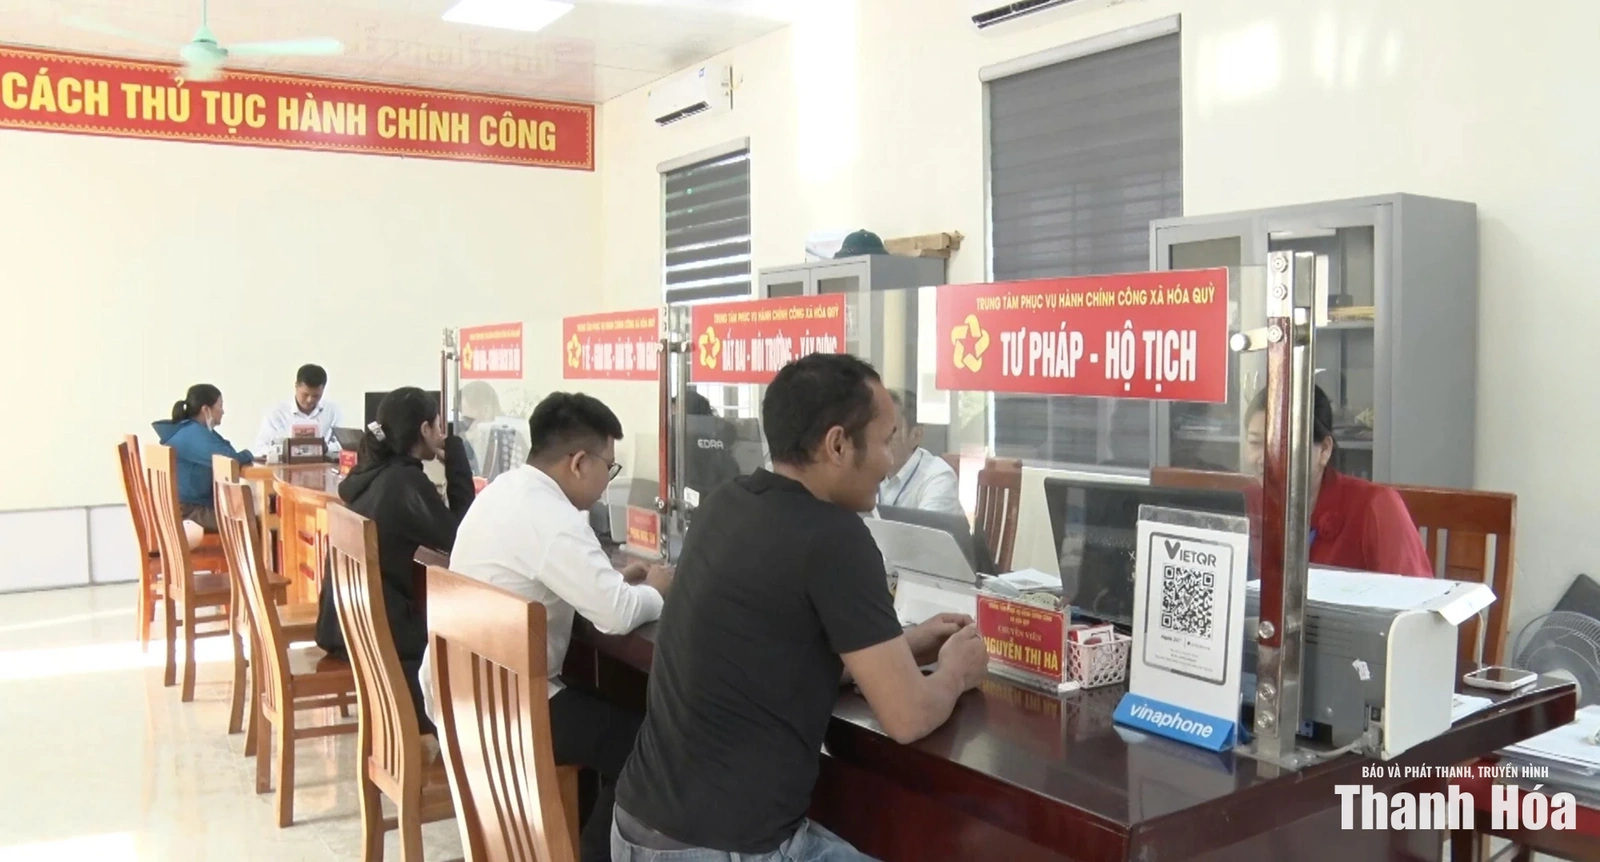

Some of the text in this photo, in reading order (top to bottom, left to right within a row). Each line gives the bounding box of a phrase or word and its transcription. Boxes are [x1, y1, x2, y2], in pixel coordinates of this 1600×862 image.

[2, 67, 556, 151] CÁCH THỦ TỤC HÀNH CHÍNH CÔNG
[976, 296, 1001, 311] TRUNG
[1002, 291, 1019, 309] TÂM
[1021, 294, 1043, 313] PHỤC
[1045, 293, 1057, 312] VỤ
[1059, 288, 1083, 308] HÀNH
[1085, 287, 1115, 307] CHÍNH
[1118, 286, 1147, 306] CÔNG
[1167, 283, 1190, 305] HÓA
[1192, 281, 1215, 304] QUỲ
[1000, 320, 1197, 392] TƯ PHÁP - HỘ TỊCH
[1165, 539, 1217, 567] VIETQR
[1025, 647, 1042, 670] THỊ
[1044, 649, 1059, 671] HÀ
[1130, 703, 1213, 738] vinaphone
